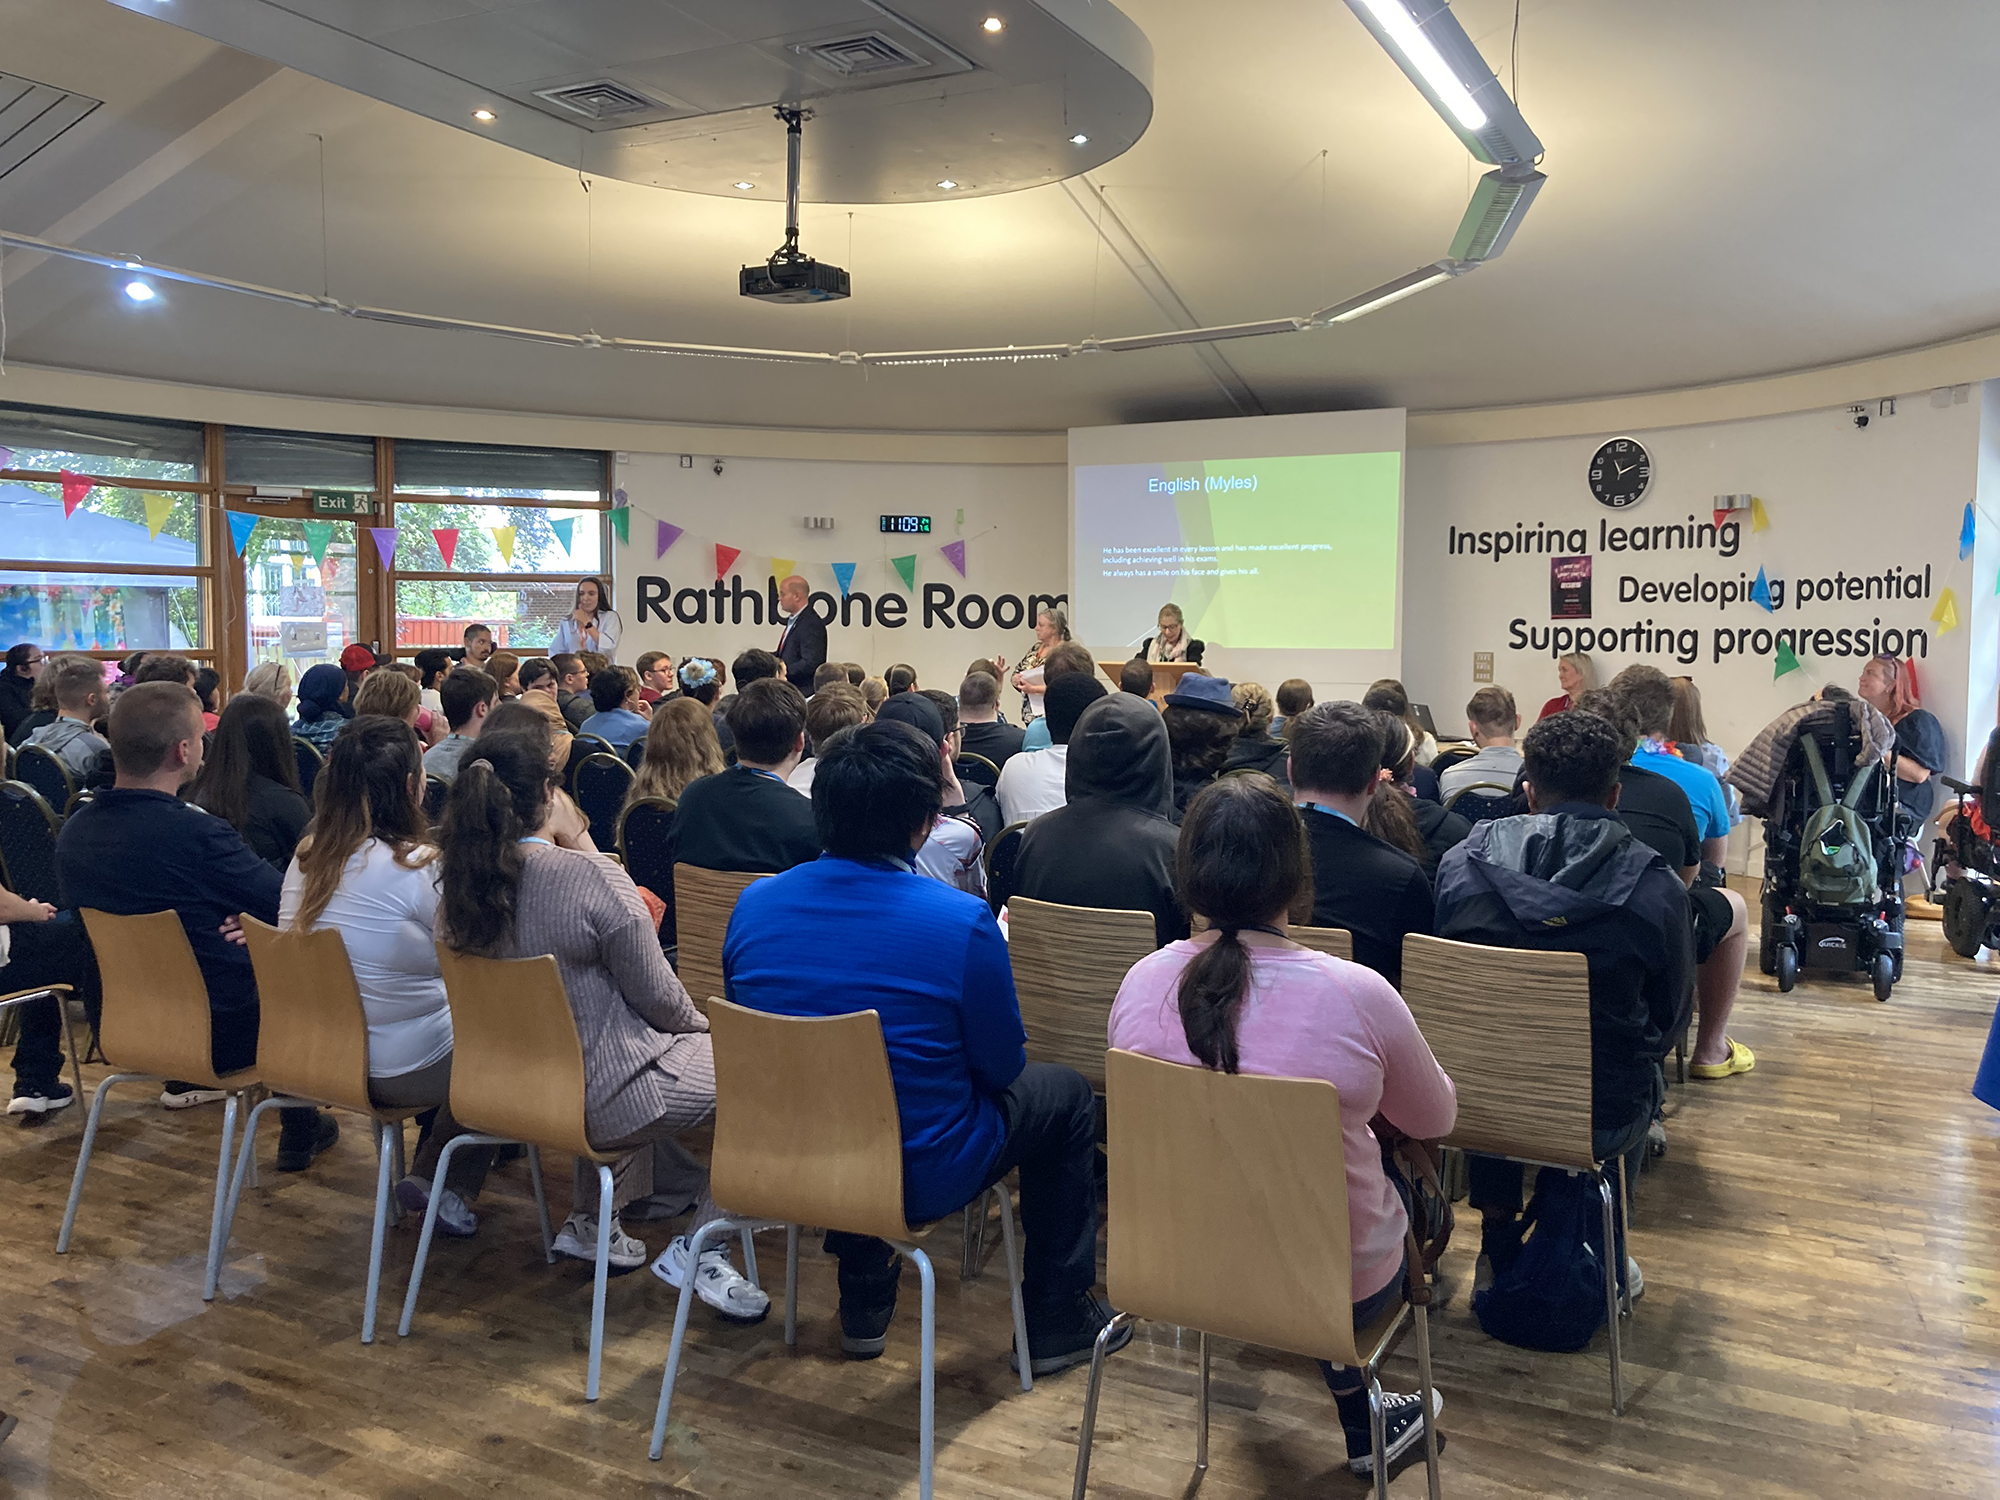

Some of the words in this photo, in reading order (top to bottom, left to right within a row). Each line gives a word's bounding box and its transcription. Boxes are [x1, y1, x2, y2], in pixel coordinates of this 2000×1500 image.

[1615, 441, 1628, 452] 12
[1639, 454, 1646, 462] 2
[1591, 469, 1602, 480] 9
[1639, 466, 1650, 478] 3
[1148, 476, 1200, 495] English
[1204, 474, 1258, 493] (Myles)
[1637, 482, 1644, 490] 4
[1605, 493, 1611, 501] 7
[1613, 494, 1625, 506] 6
[1629, 492, 1636, 500] 5
[318, 495, 347, 509] Exit
[1449, 522, 1587, 562] Inspiring
[1600, 515, 1740, 557] learning
[1142, 545, 1171, 553] excellent
[1172, 545, 1178, 553] in
[1179, 545, 1197, 554] every
[1199, 544, 1219, 552] lesson
[1221, 543, 1234, 552] and
[1235, 544, 1247, 552] has
[1248, 543, 1267, 551] made
[1268, 542, 1299, 551] excellent
[1102, 556, 1131, 565] including
[1132, 555, 1162, 565] achieving
[1163, 555, 1177, 563] well
[1178, 555, 1184, 563] in
[1113, 569, 1134, 578] always
[1135, 569, 1146, 577] has
[1152, 568, 1169, 577] smile
[1180, 567, 1190, 576] his
[1191, 567, 1205, 576] face
[1206, 567, 1219, 576] and
[1219, 568, 1237, 577] gives
[1238, 567, 1248, 576] his
[1619, 572, 1785, 610] Developig
[1796, 563, 1931, 610] potential
[1508, 618, 1698, 665] Supporting
